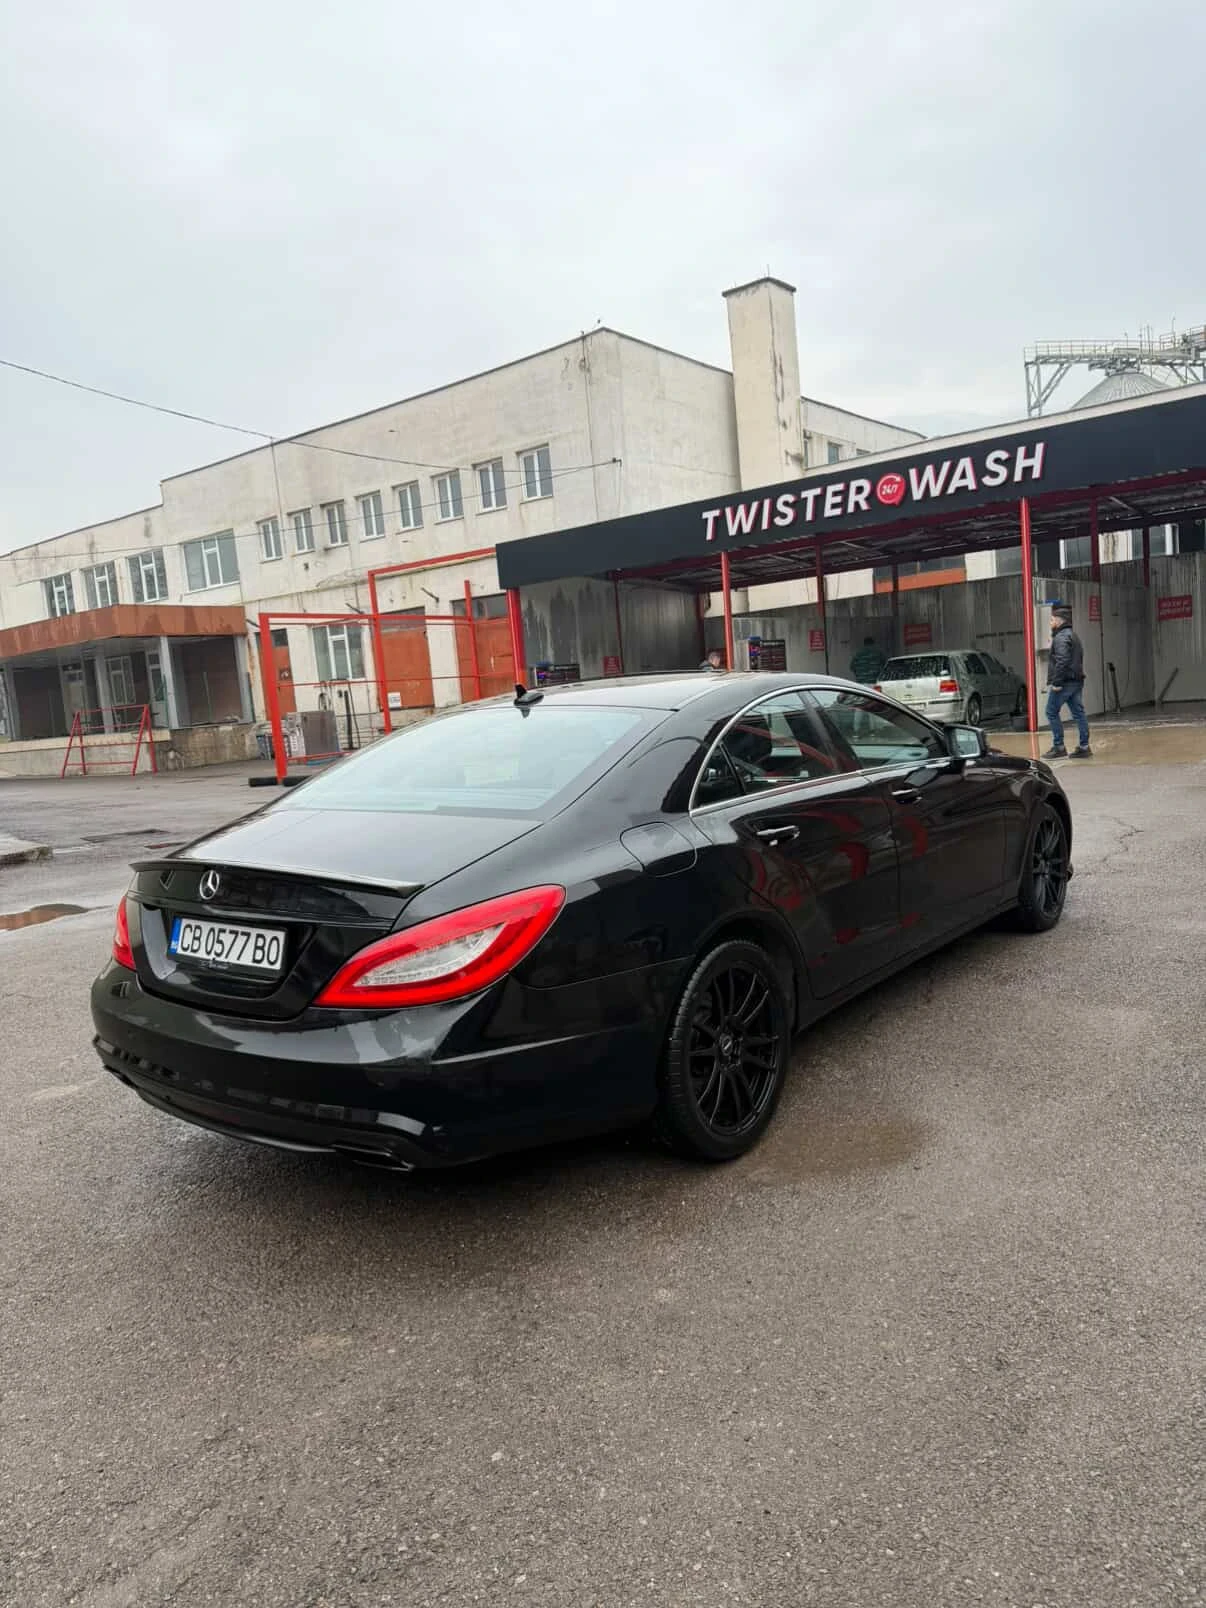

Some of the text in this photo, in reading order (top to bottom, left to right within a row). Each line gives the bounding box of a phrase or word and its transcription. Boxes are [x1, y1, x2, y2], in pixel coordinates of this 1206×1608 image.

[702, 479, 871, 541] TWISTER
[909, 442, 1045, 501] WASH
[180, 924, 202, 953] CB
[205, 927, 251, 960] 0577
